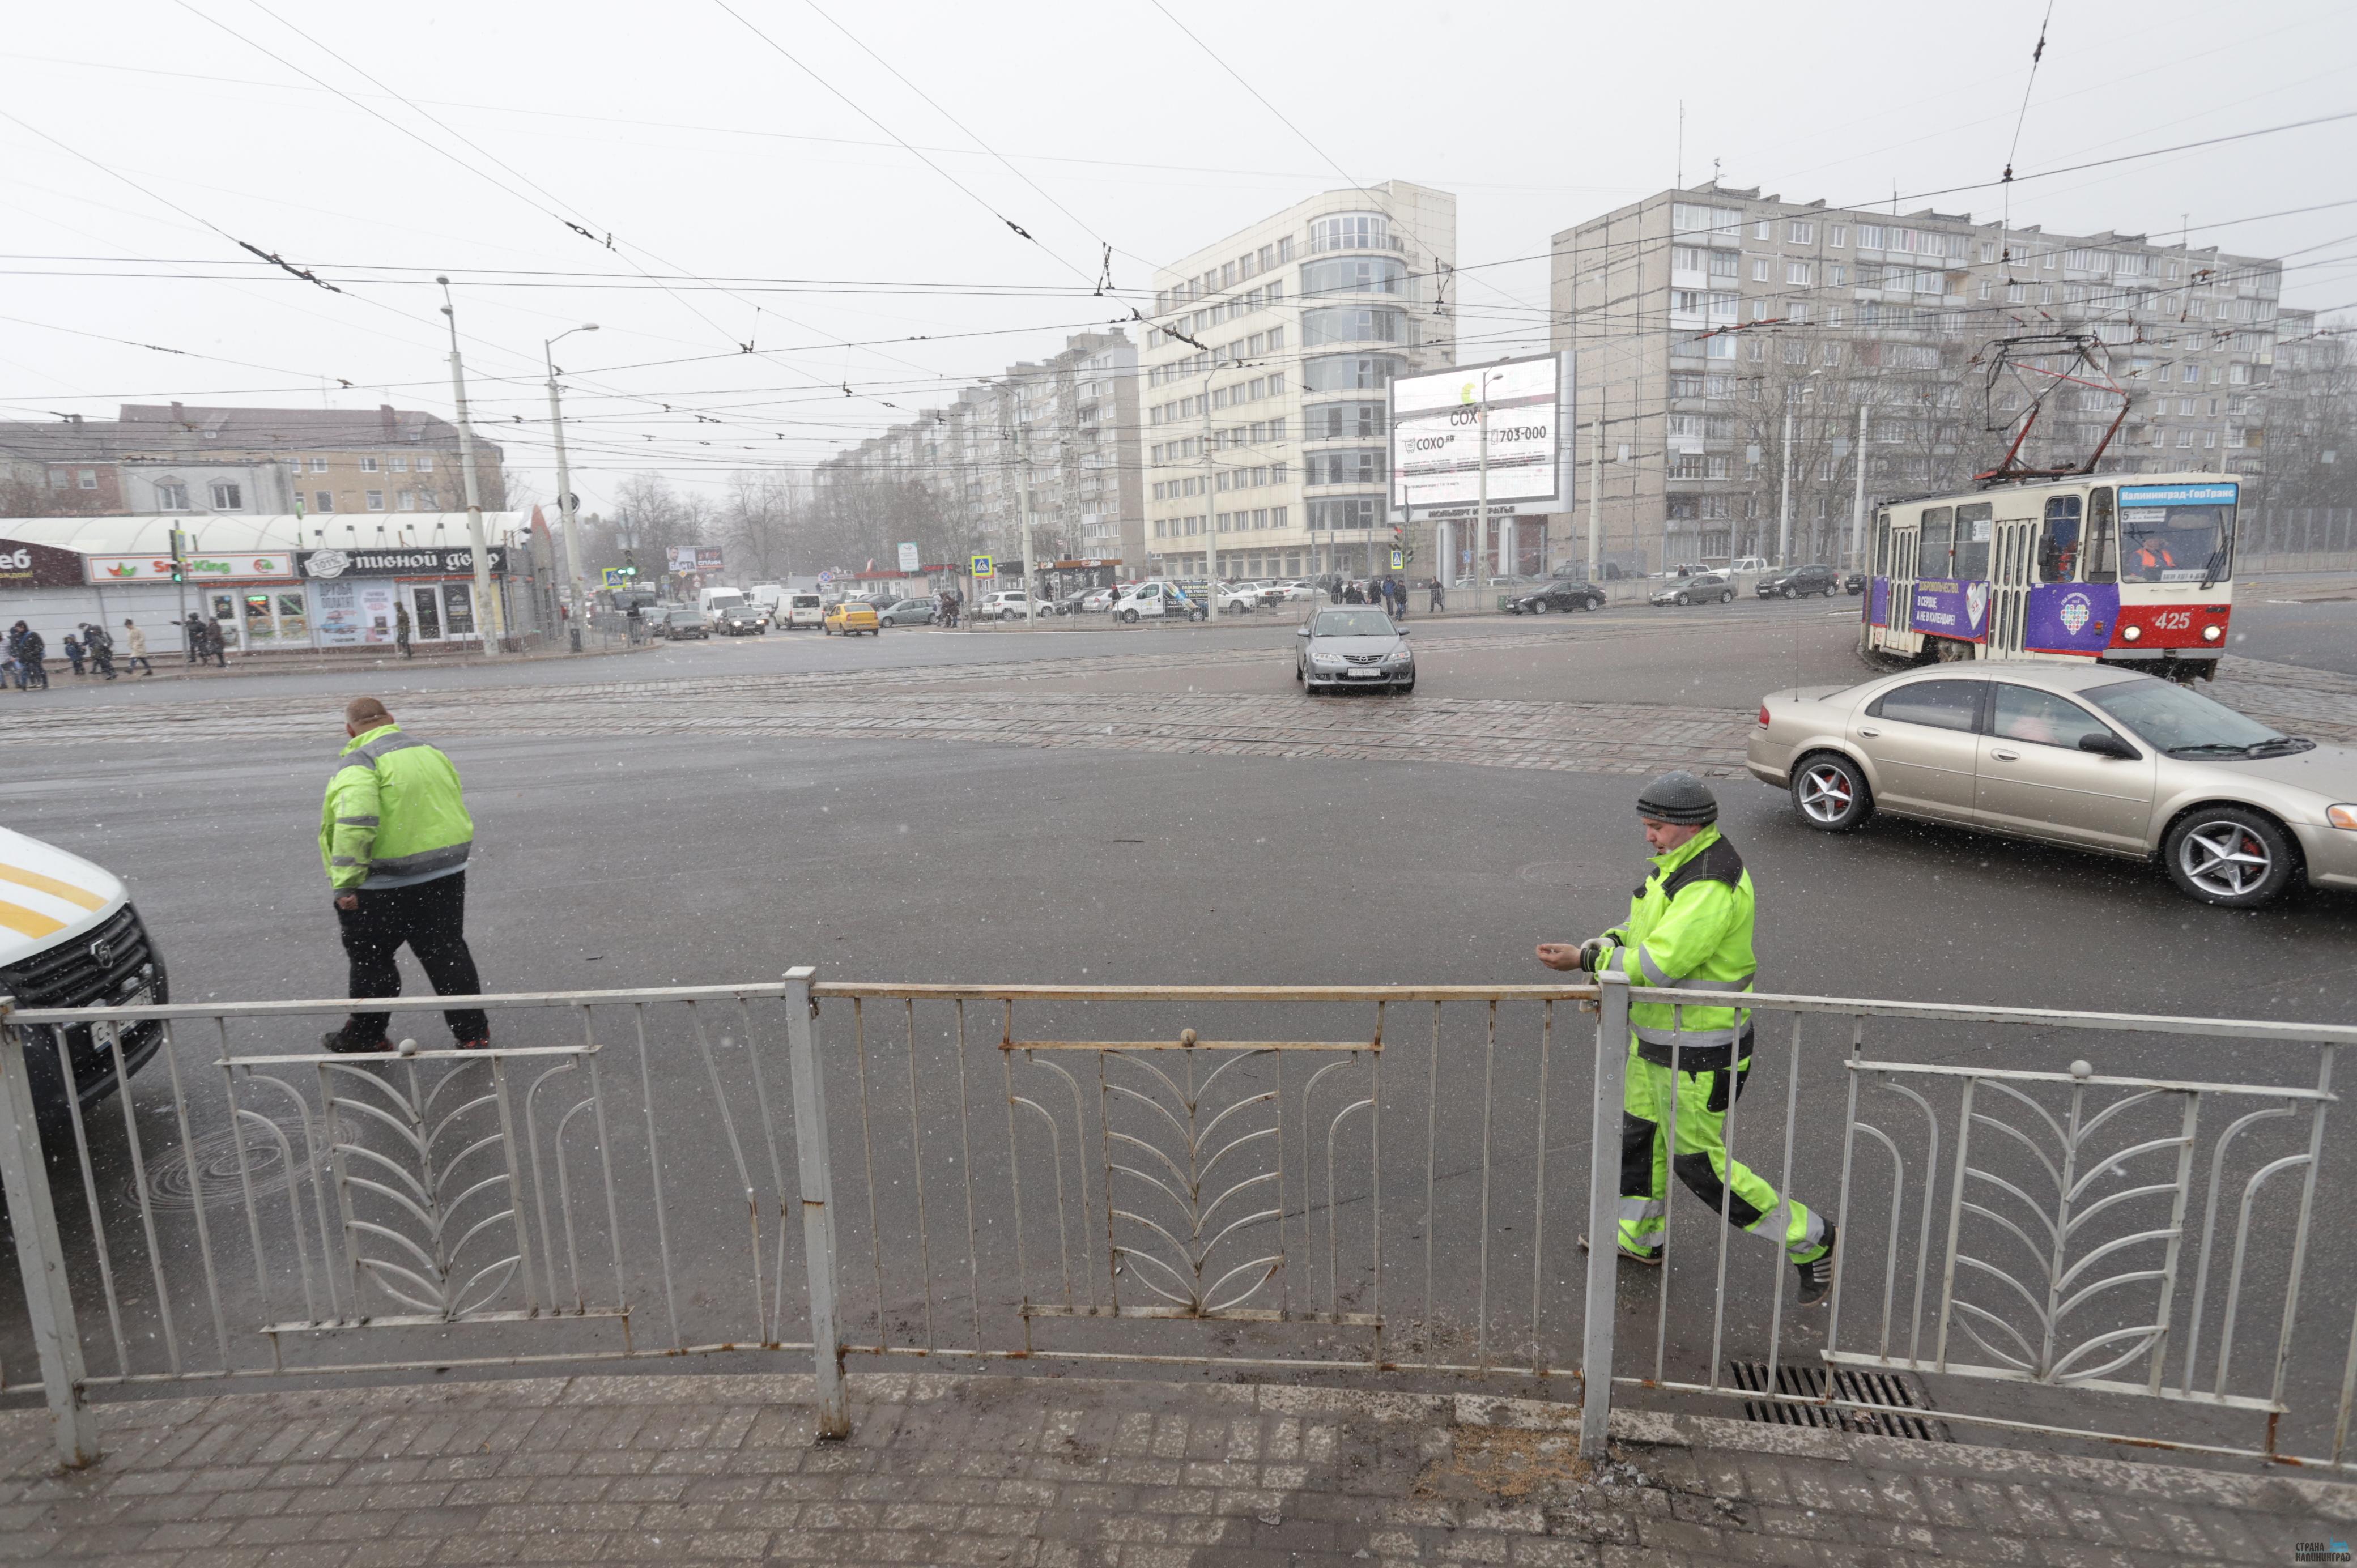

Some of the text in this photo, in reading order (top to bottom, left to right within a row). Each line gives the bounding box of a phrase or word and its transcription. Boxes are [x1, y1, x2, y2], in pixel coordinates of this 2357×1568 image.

[1500, 426, 1546, 442] 703-000
[2122, 489, 2234, 500] Калининград-ГорТранс
[1487, 506, 1515, 514] РАТЬЯ
[2122, 511, 2129, 520] 5
[445, 552, 500, 570] двр
[1917, 596, 1921, 606] В
[1916, 611, 1920, 620] А
[1920, 611, 1926, 621] НЕ
[1926, 612, 1929, 621] В
[2155, 612, 2191, 629] 425
